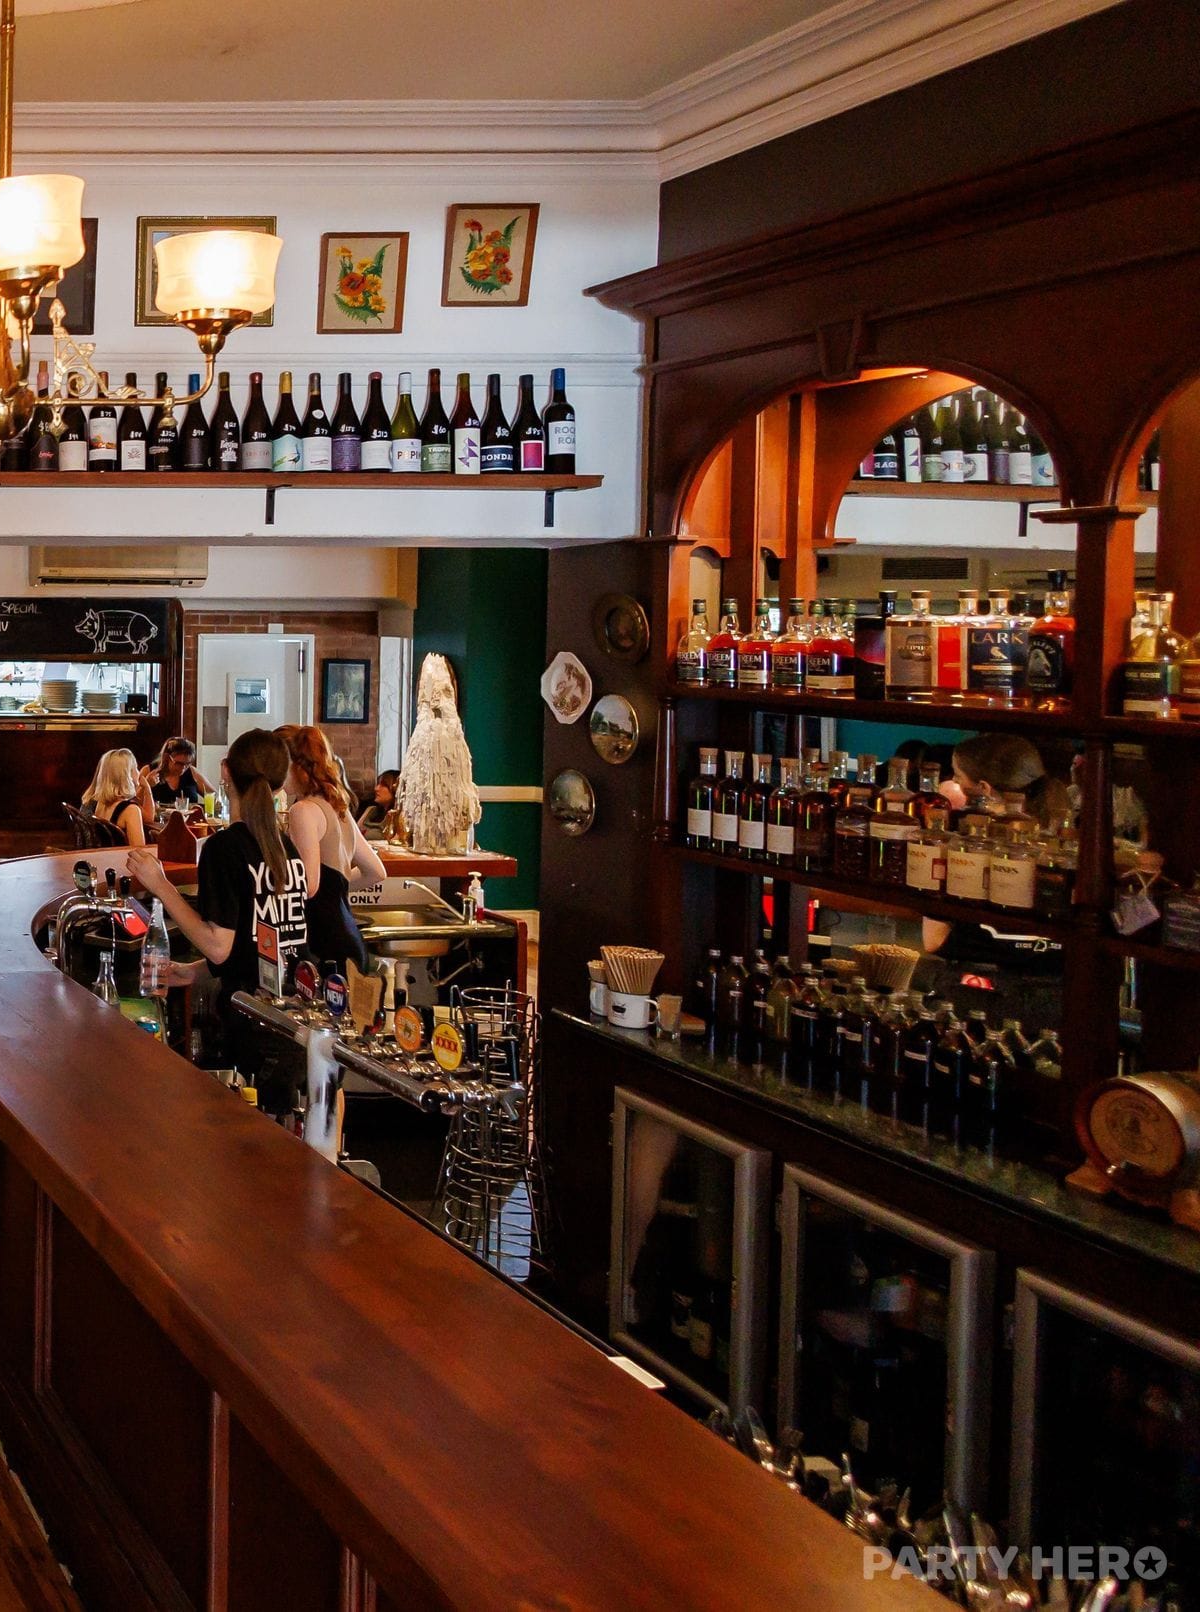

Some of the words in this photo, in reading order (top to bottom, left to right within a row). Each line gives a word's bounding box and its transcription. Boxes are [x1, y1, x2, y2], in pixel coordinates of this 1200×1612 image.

[432, 424, 447, 435] $60
[971, 632, 1024, 644] LARK
[350, 895, 380, 904] ONLY
[327, 989, 344, 1006] NEW
[436, 1035, 458, 1053] XXXX
